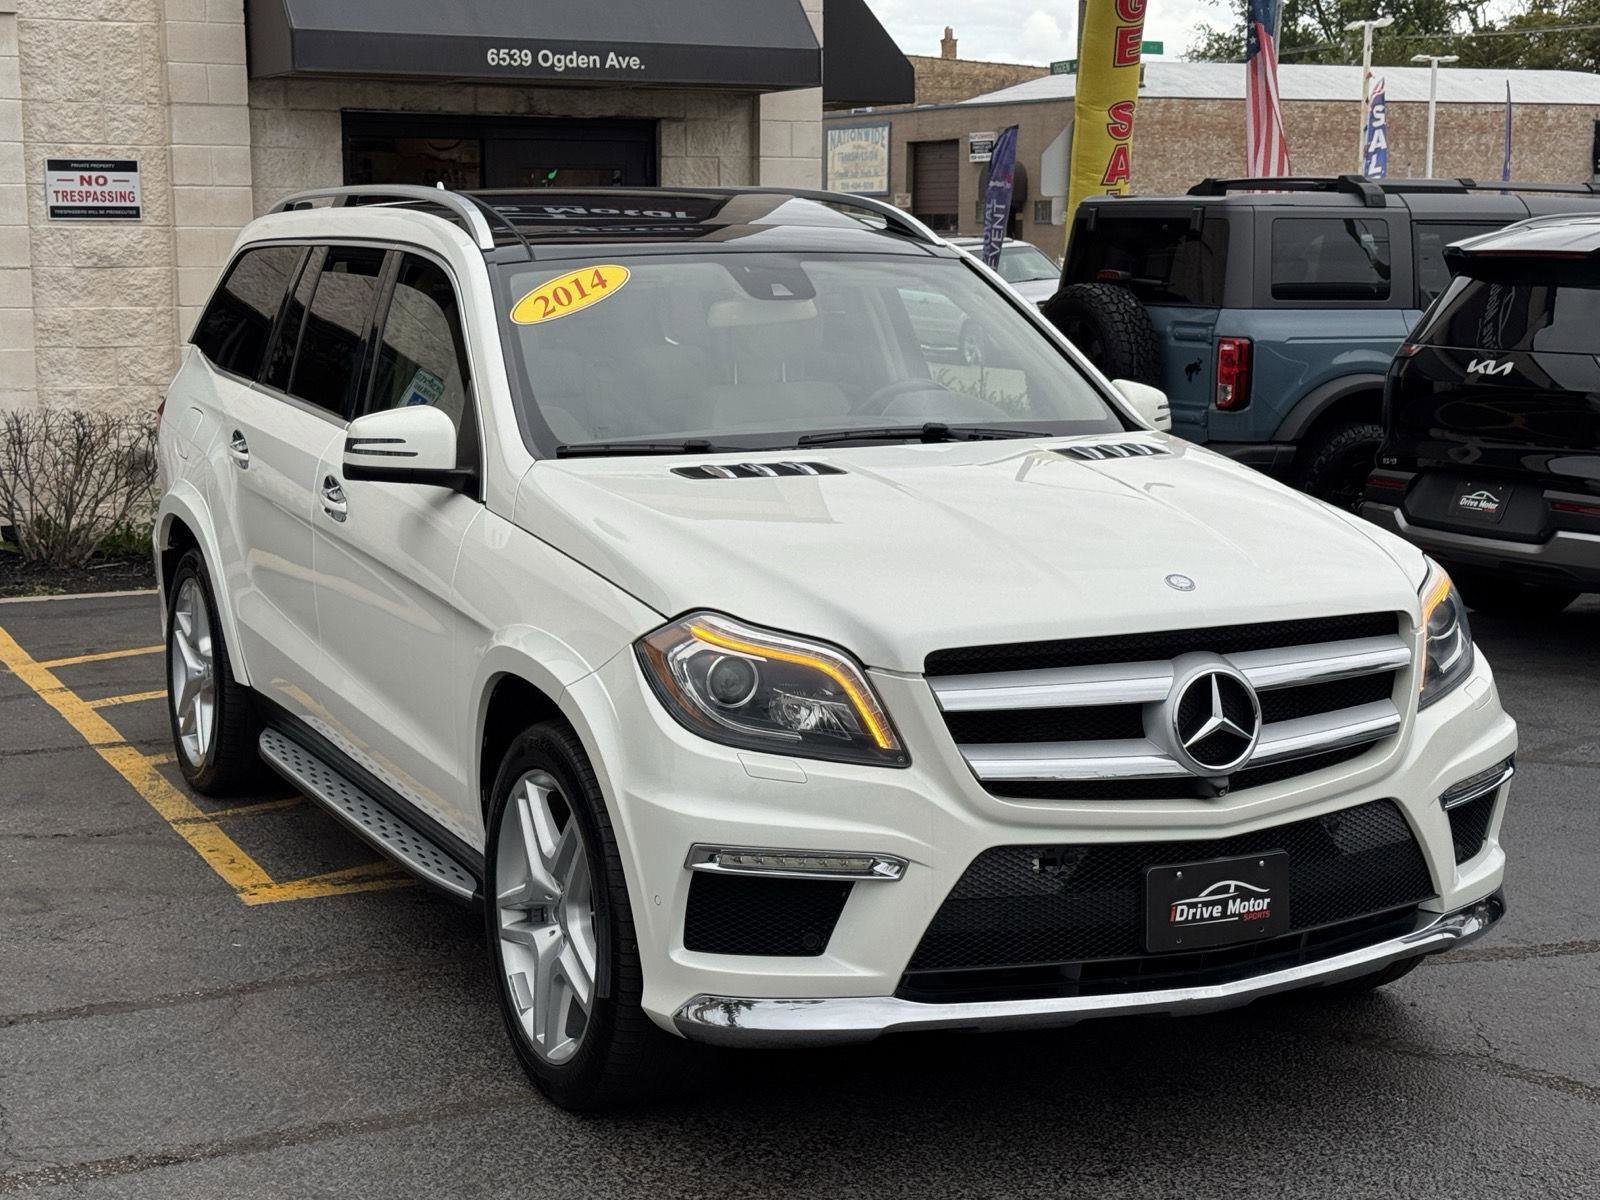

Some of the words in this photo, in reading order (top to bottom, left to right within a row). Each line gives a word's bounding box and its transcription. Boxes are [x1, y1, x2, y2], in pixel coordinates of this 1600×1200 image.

[487, 48, 532, 67] 6539
[538, 50, 600, 72] Ogden
[605, 52, 646, 70] Ave.
[1101, 101, 1136, 196] SA
[1368, 105, 1387, 178] SAL
[79, 174, 108, 187] NO
[53, 190, 136, 203] TRESPASSING
[533, 268, 608, 318] 2014
[1479, 500, 1499, 510] Motor
[1227, 898, 1271, 915] Motor
[1243, 910, 1270, 921] SPORTS
